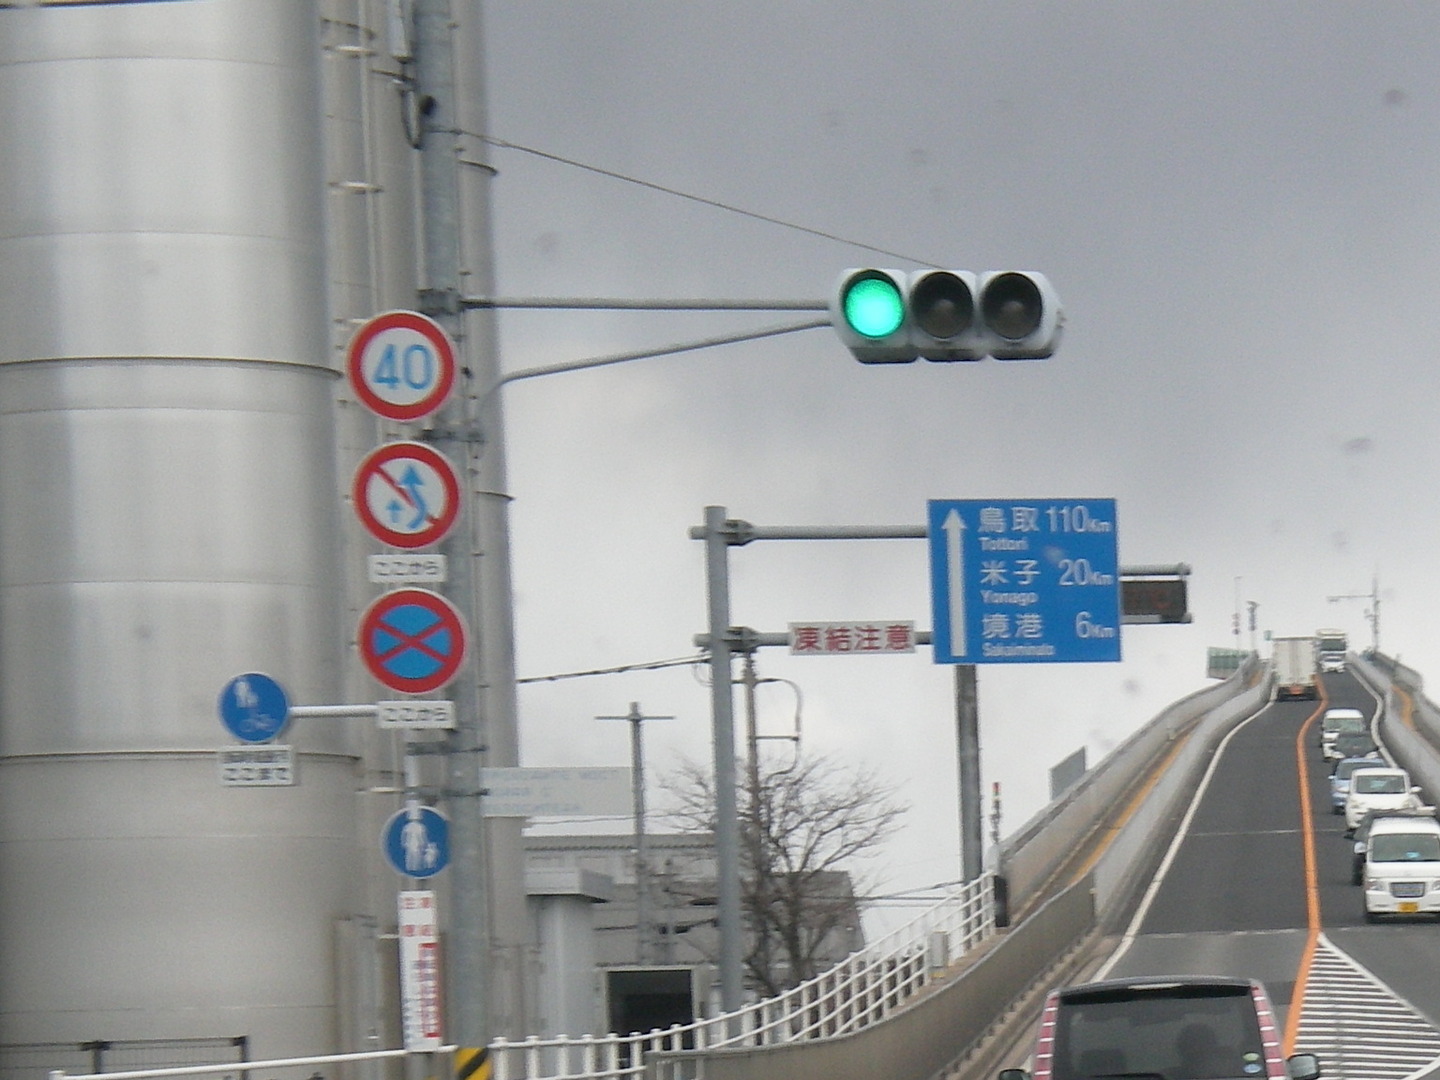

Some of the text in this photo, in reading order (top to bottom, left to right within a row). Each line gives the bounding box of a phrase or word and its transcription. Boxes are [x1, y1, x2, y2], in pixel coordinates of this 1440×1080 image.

[372, 343, 435, 391] 40
[978, 506, 1040, 533] 鳥取
[978, 537, 1029, 551] Tottori
[375, 560, 440, 577] ここから
[980, 559, 1041, 586] 米子
[980, 590, 1038, 606] Yonago
[793, 624, 911, 651] 凍結注意
[982, 613, 1043, 639] 境港
[385, 707, 447, 723] ここから
